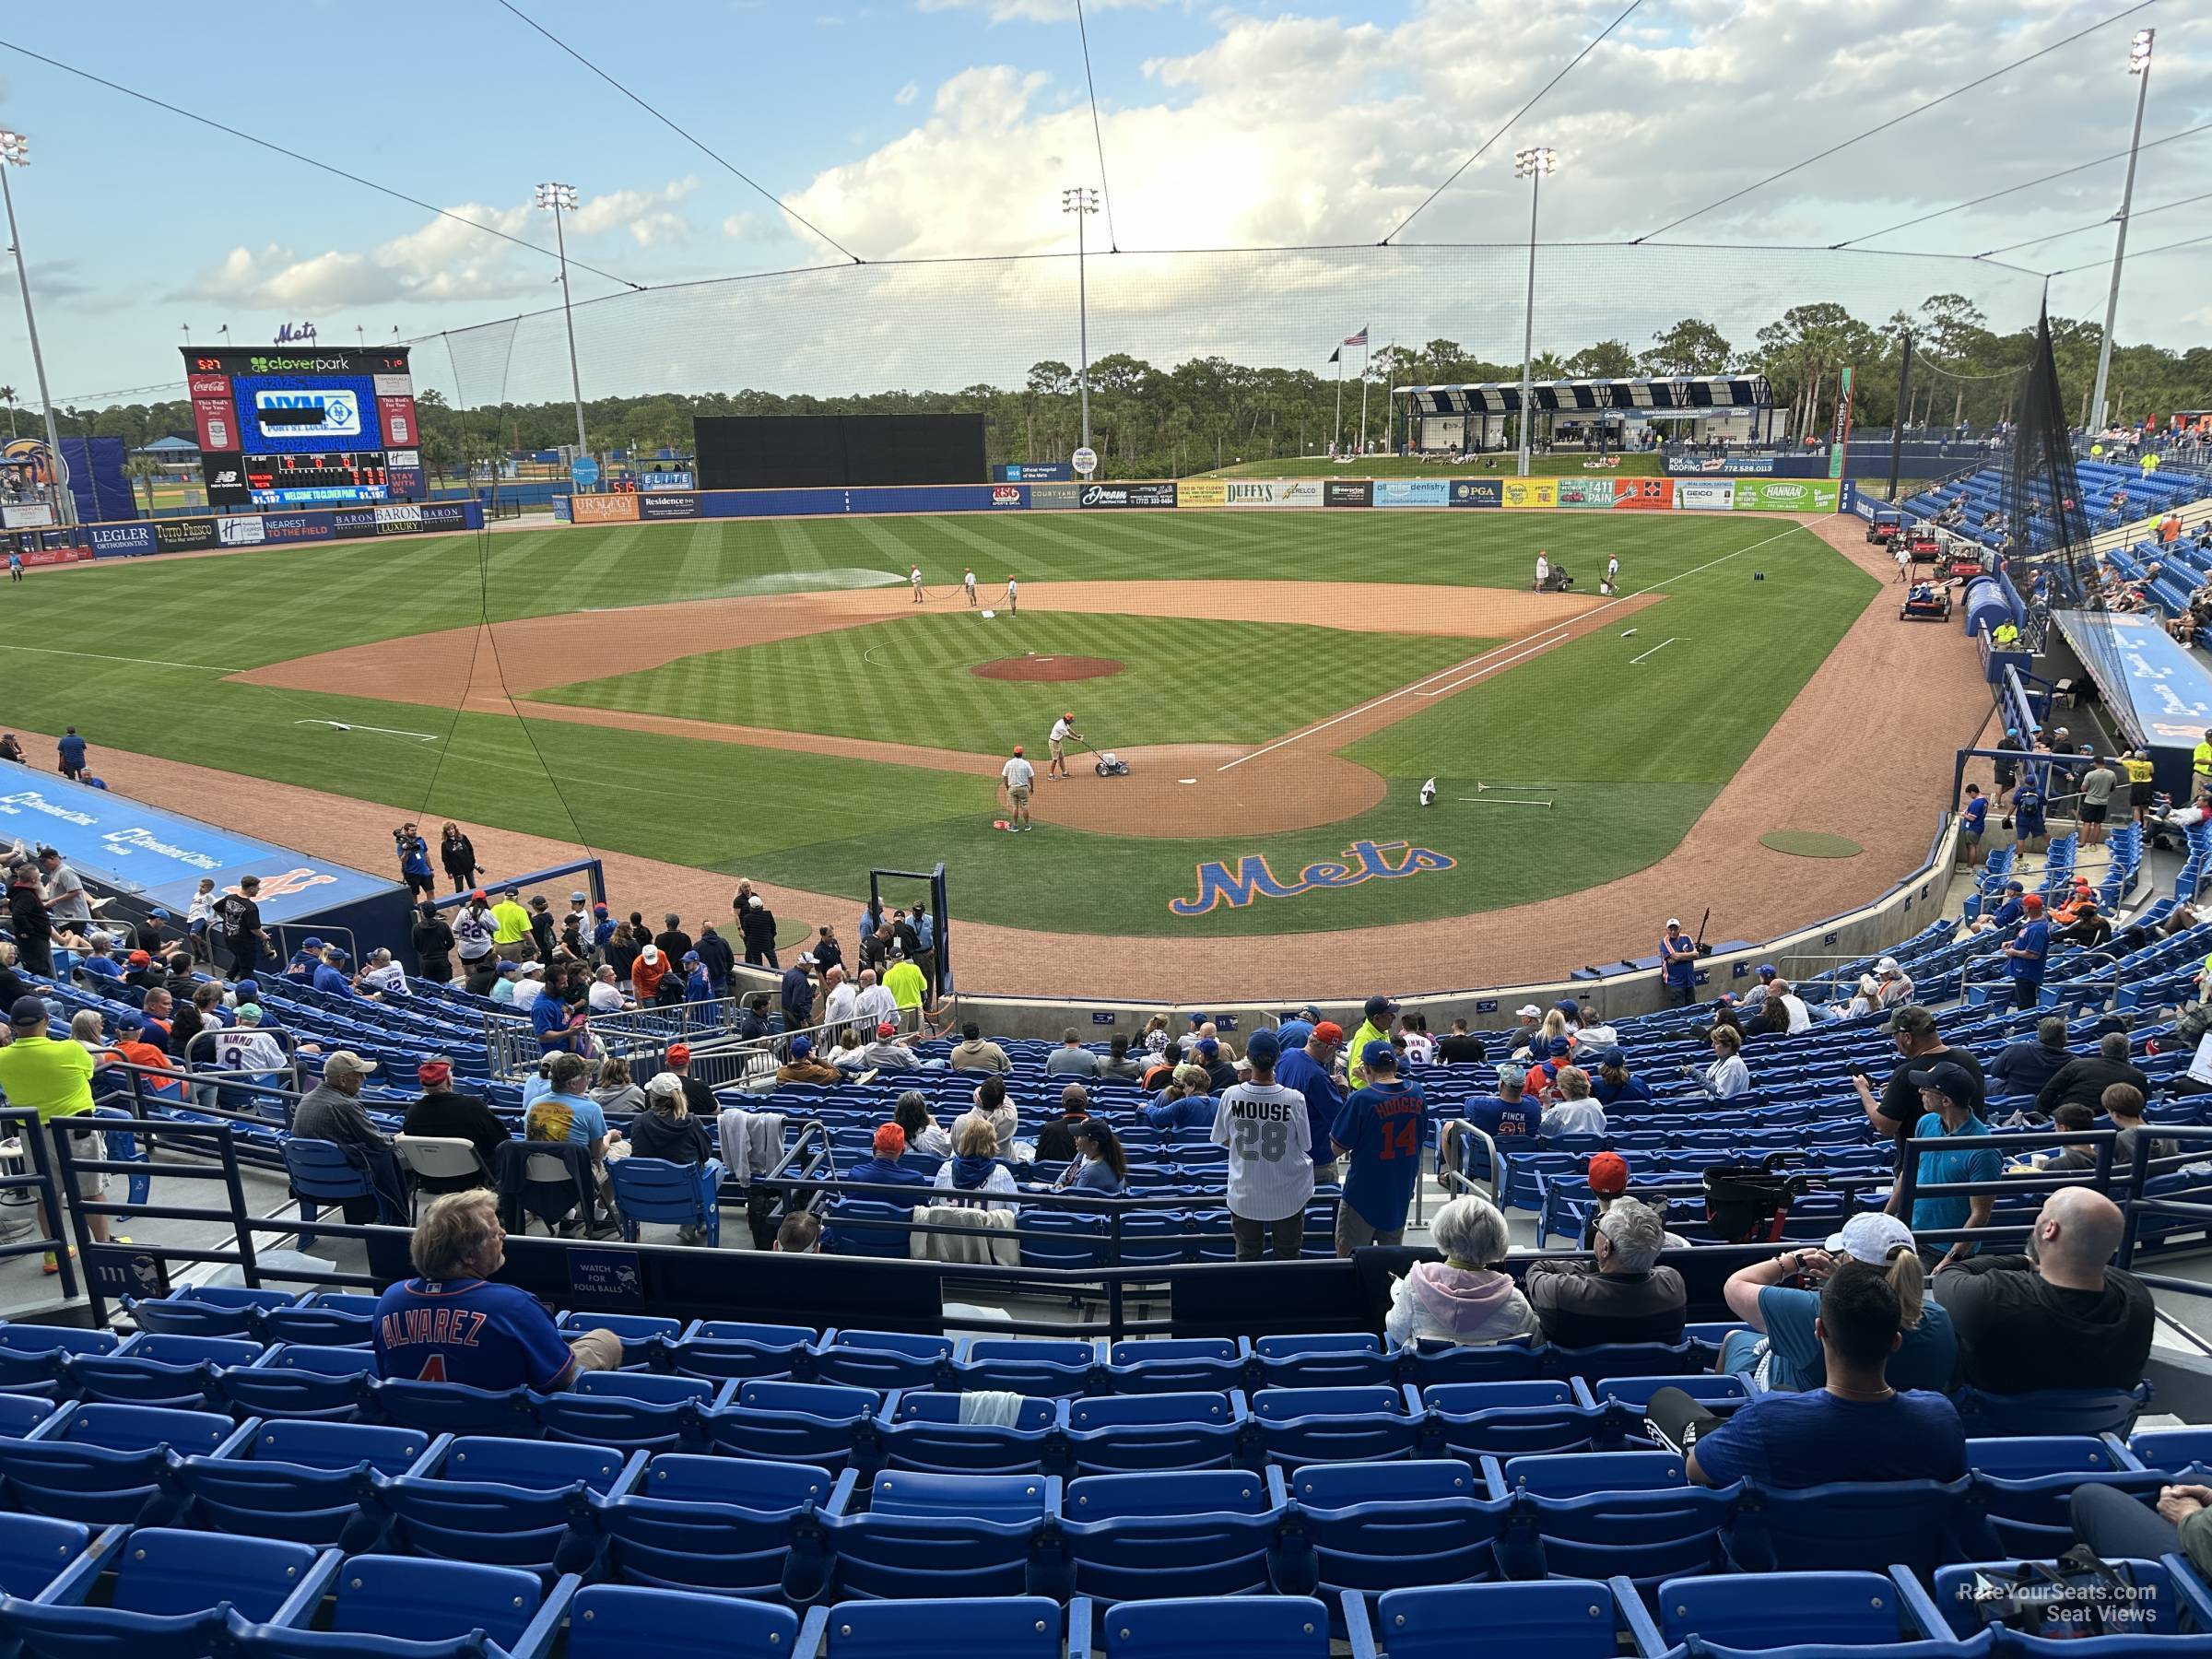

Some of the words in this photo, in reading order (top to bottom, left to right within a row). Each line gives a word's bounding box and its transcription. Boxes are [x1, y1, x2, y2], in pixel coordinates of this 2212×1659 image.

[274, 322, 317, 344] Mets
[645, 474, 689, 484] ELITE
[1410, 483, 1445, 491] dentistry
[1469, 488, 1494, 496] PGA
[1593, 481, 1613, 492] 411
[1766, 486, 1801, 497] HANNAN
[284, 490, 313, 500] WELCOME
[313, 490, 321, 500] TO
[322, 490, 341, 499] CLOVER
[341, 489, 357, 498] PARK
[994, 487, 1018, 498] RSG
[1083, 486, 1126, 504] Dream
[1228, 485, 1272, 502] DUFFY'S
[1588, 494, 1612, 502] PAIN
[335, 514, 372, 524] BARON
[376, 507, 420, 522] BARON
[423, 509, 458, 518] BARON
[265, 520, 306, 529] NEAREST
[382, 522, 418, 532] LUXURY
[92, 527, 149, 542] LEGLER
[267, 529, 280, 537] TO
[302, 526, 328, 535] FIELD
[98, 540, 147, 549] ORTHODONTICS
[180, 853, 223, 869] Clinic
[1169, 841, 1457, 915] Mets
[461, 923, 483, 938] 22
[223, 1034, 253, 1046] NIMMO
[225, 1047, 242, 1069] 9
[1411, 1050, 1423, 1063] 9
[1231, 1100, 1291, 1122] MOUSE
[1375, 1097, 1423, 1119] HODGES
[1502, 1112, 1525, 1121] FINCH
[1234, 1119, 1288, 1162] 28
[1379, 1117, 1417, 1159] 14
[99, 1266, 125, 1282] 111
[581, 1264, 611, 1273] WATCH
[588, 1274, 606, 1282] FOR
[573, 1283, 594, 1291] FOUL
[598, 1285, 623, 1294] BALLS
[382, 1309, 487, 1349] ALVAREZ
